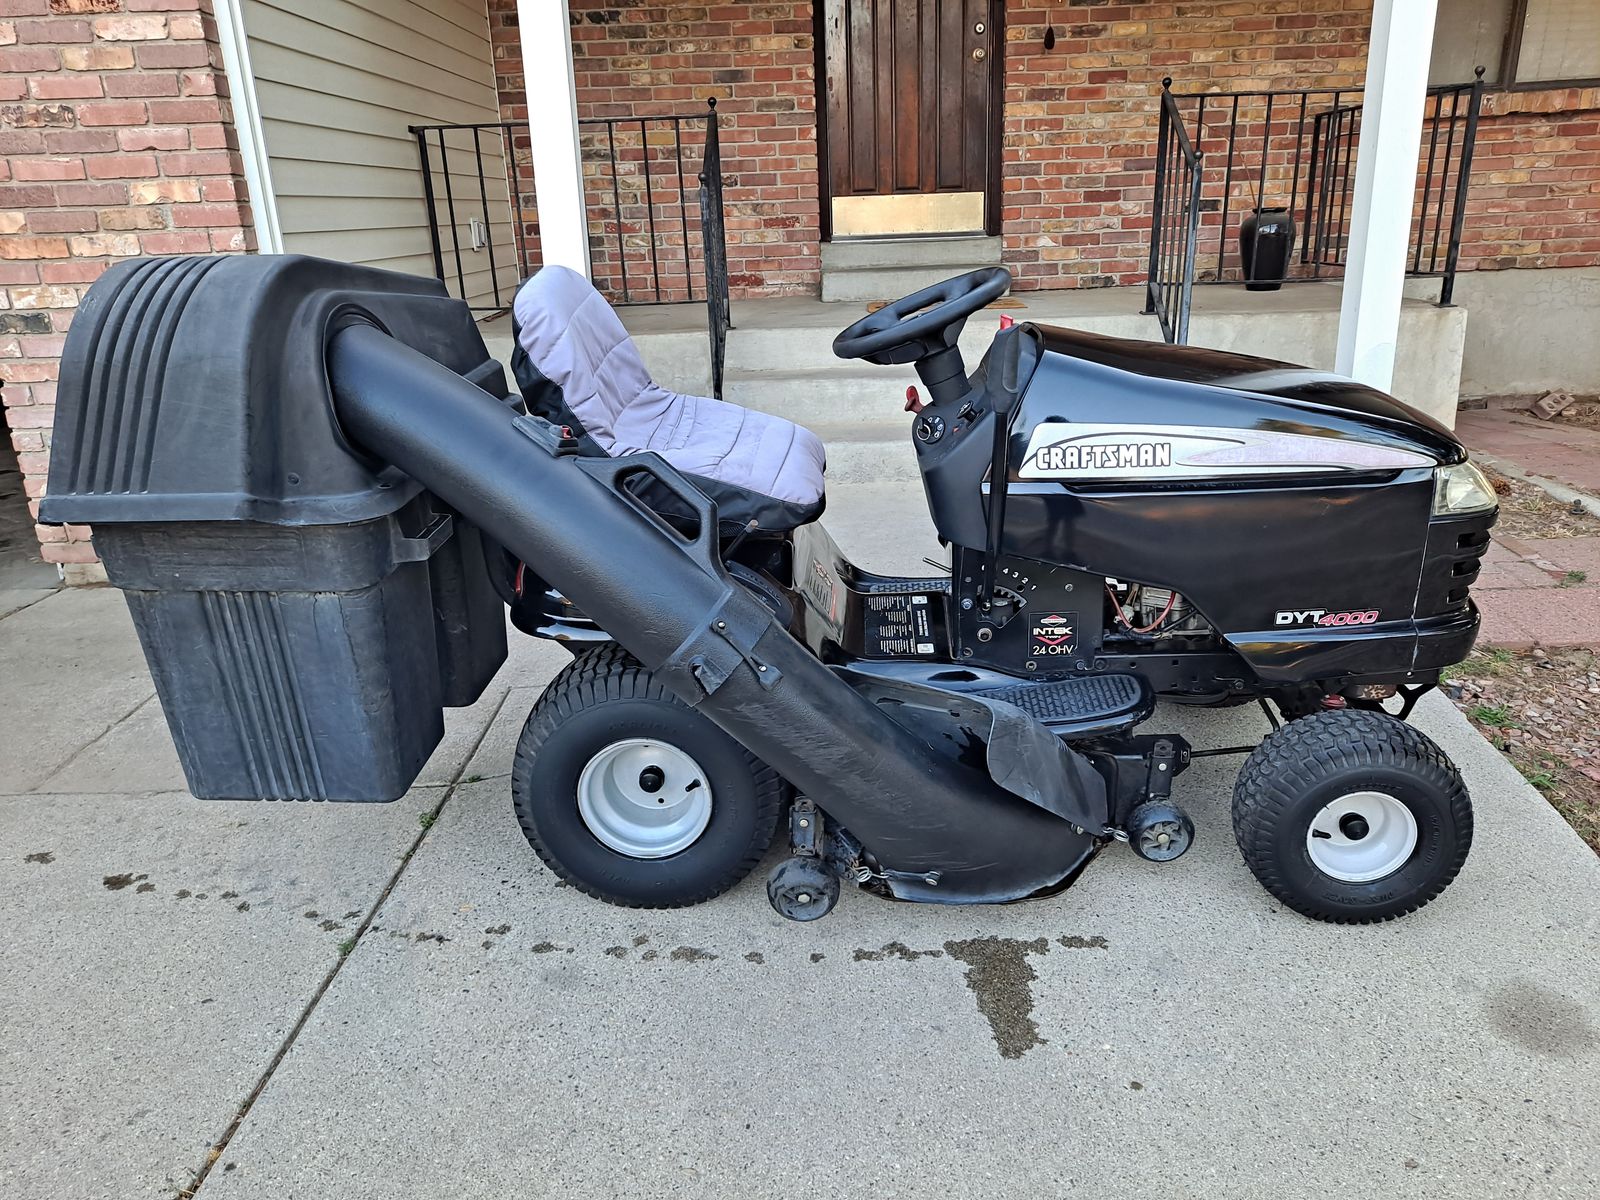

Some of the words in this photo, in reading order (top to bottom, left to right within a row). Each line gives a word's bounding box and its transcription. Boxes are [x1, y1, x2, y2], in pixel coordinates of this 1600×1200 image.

[1035, 442, 1171, 470] CRAFTSMAN
[1275, 610, 1325, 625] DYT
[1318, 610, 1380, 626] 4000
[1033, 626, 1073, 635] INTEK
[1032, 645, 1046, 655] 24
[1048, 644, 1073, 655] OHV
